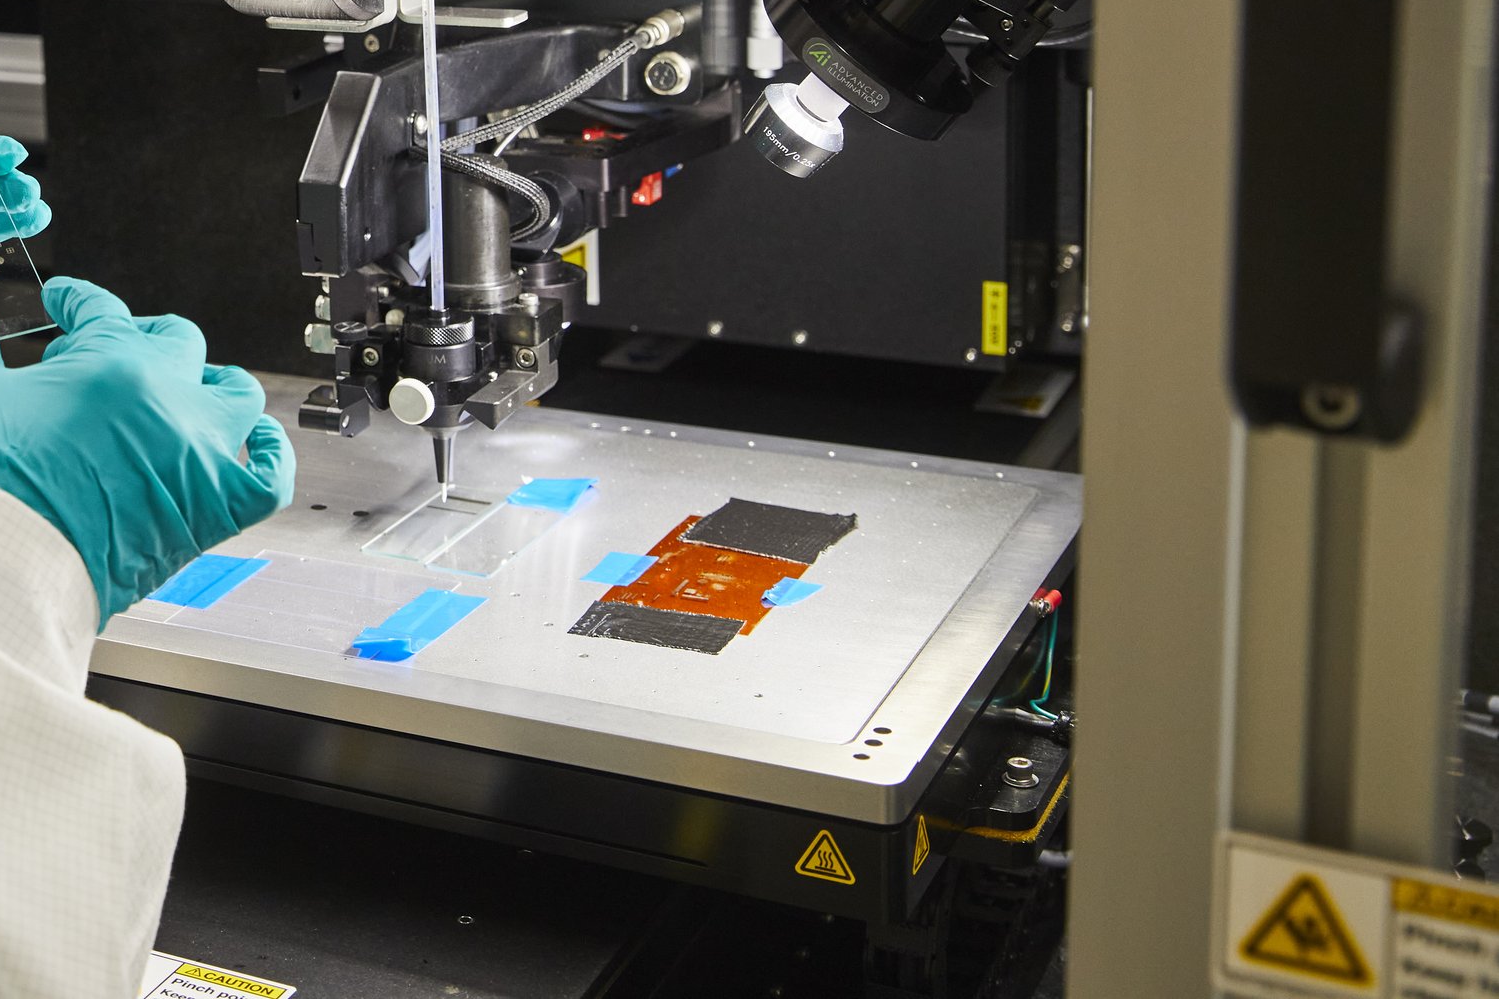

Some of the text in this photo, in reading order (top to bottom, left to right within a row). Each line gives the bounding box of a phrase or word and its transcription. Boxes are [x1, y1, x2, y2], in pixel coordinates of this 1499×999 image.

[827, 66, 880, 107] ILLUMINATION
[832, 62, 884, 101] ADVANCED
[171, 978, 215, 995] Pinch
[204, 972, 274, 996] CAUTION
